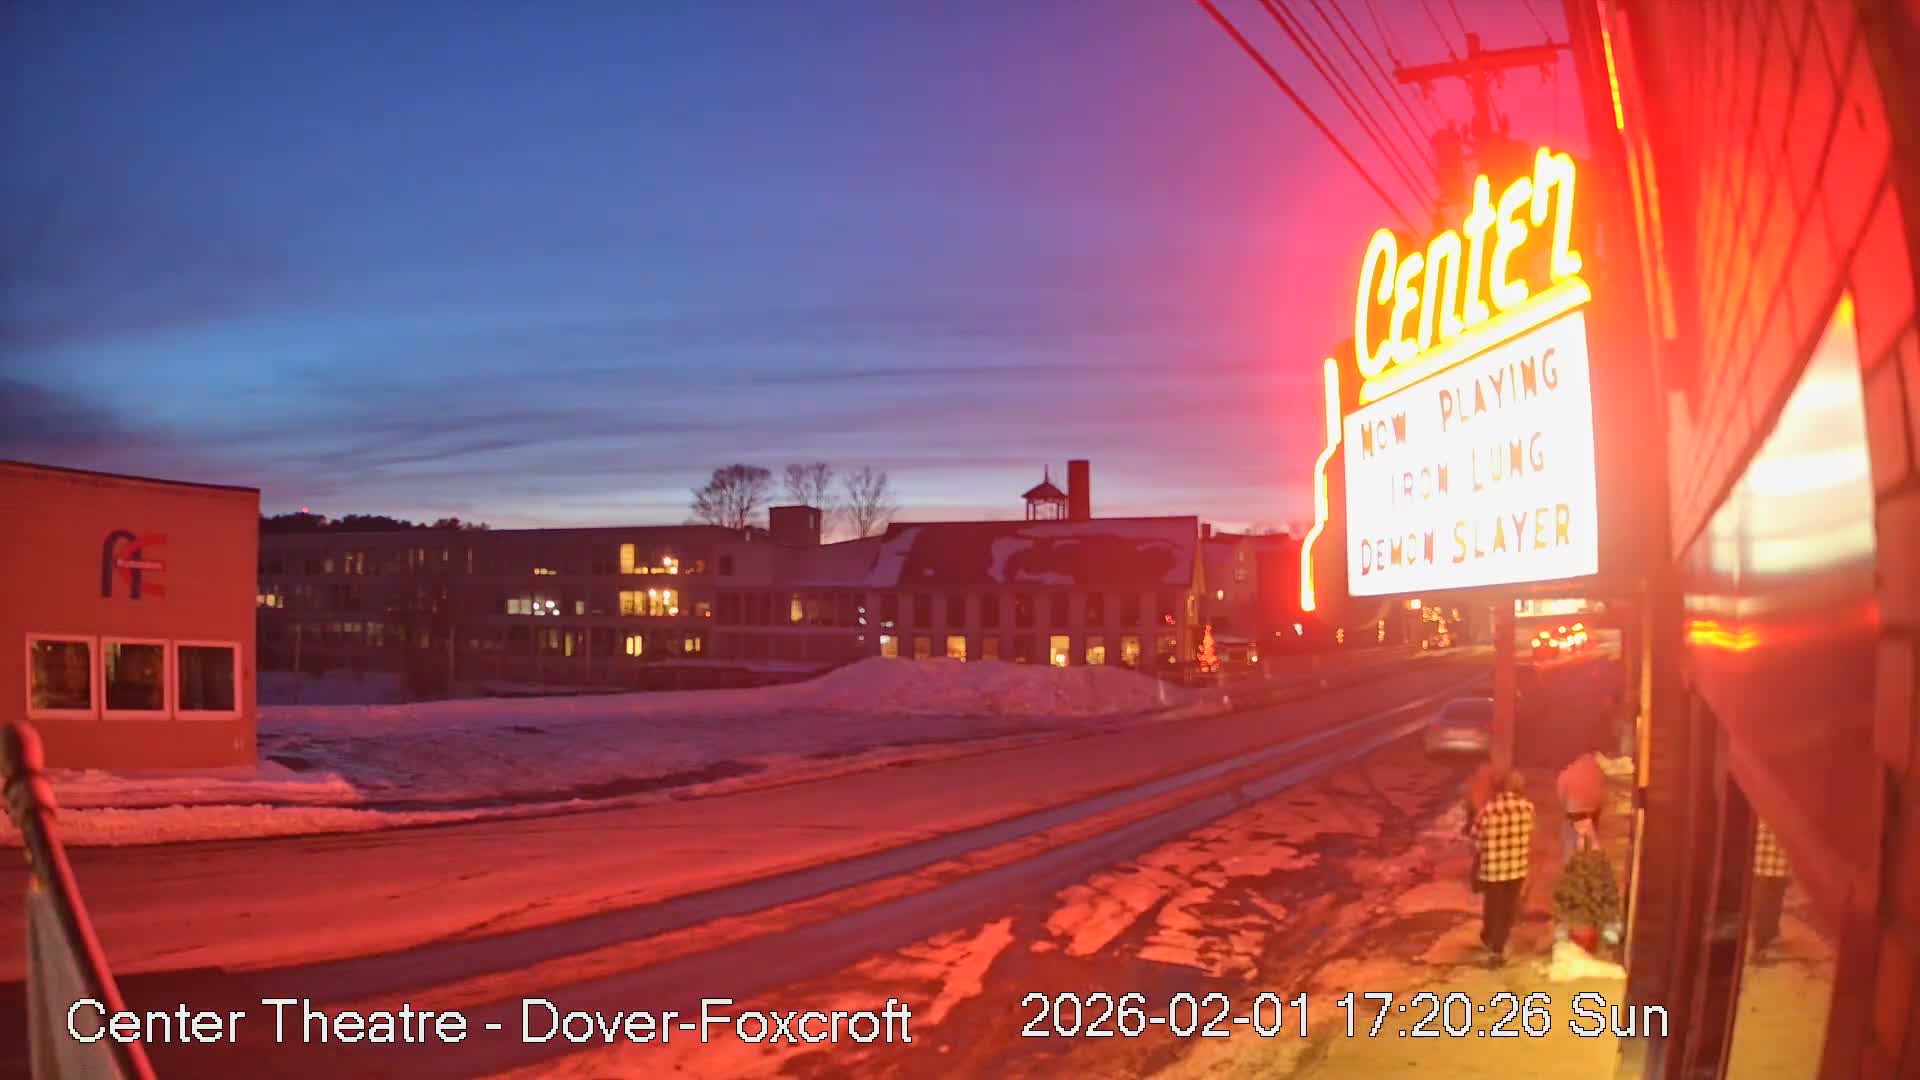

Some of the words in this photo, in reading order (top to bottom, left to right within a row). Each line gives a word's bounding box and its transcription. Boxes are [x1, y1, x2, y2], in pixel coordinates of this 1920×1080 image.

[1354, 145, 1583, 380] Center
[1361, 412, 1407, 461] NOW
[1440, 347, 1559, 432] PLAYING
[1391, 462, 1449, 505] IRON
[1472, 431, 1545, 492] LUNG
[1361, 527, 1434, 577] DEMON
[1452, 503, 1571, 564] SLAYER
